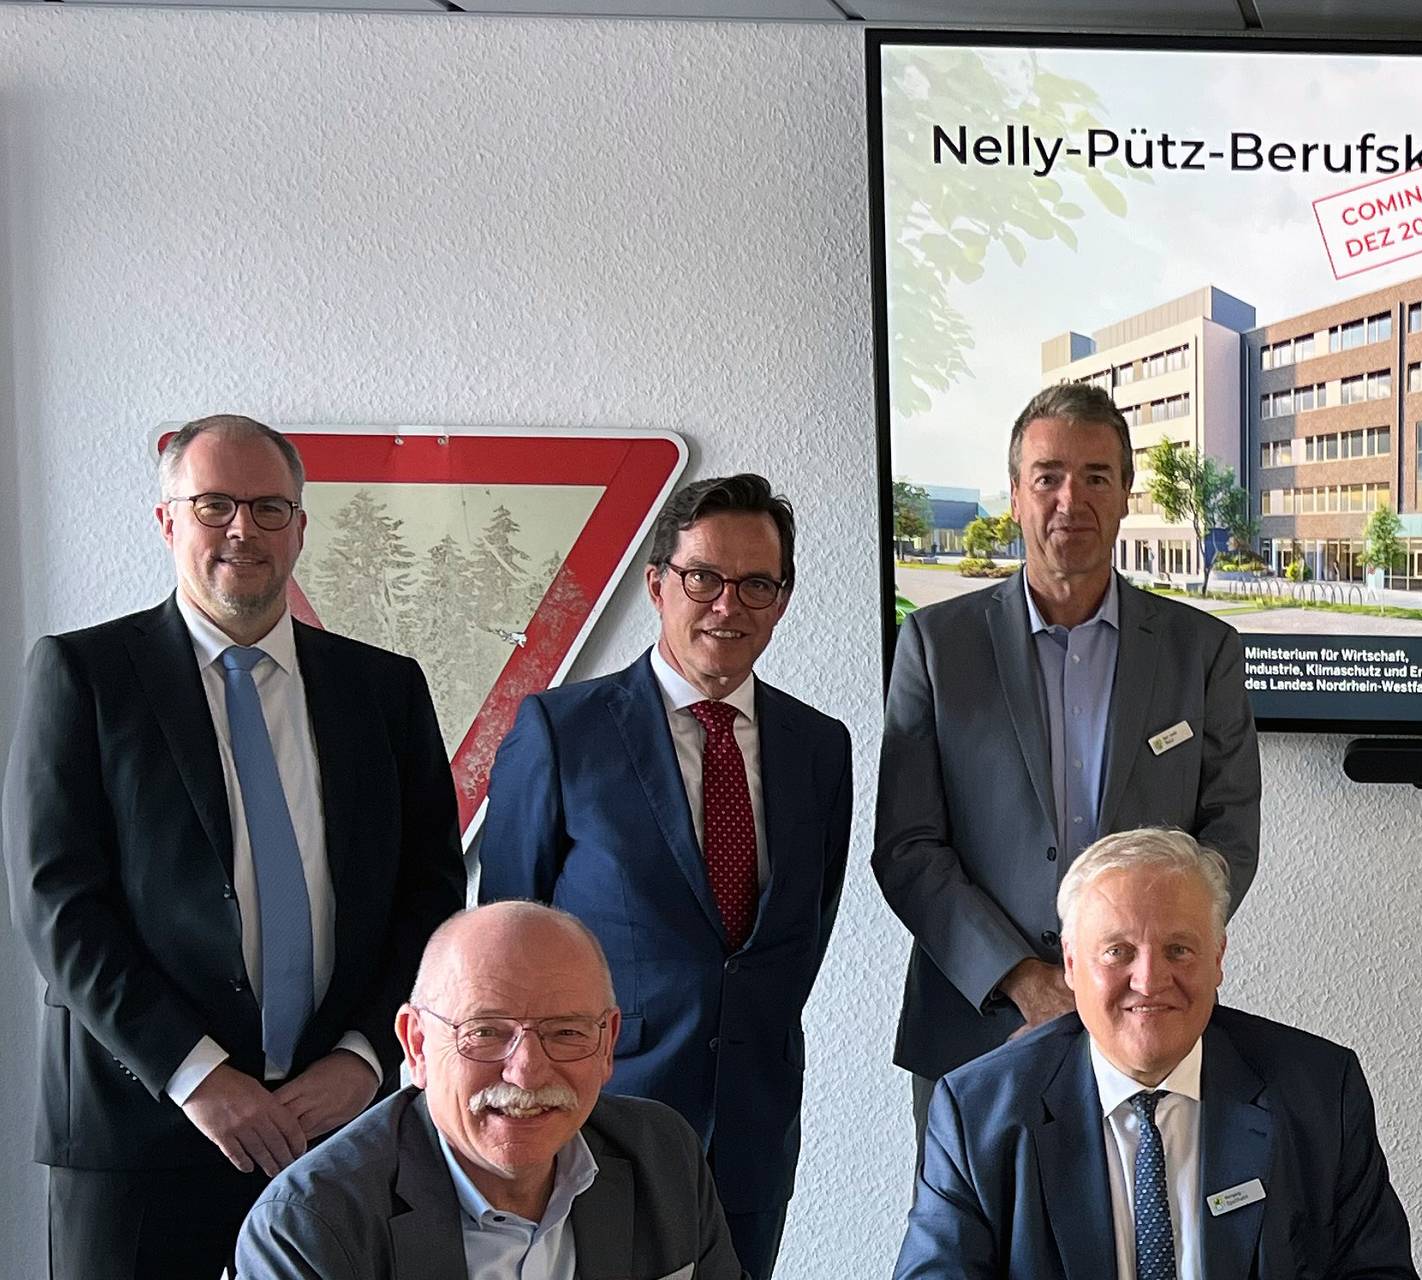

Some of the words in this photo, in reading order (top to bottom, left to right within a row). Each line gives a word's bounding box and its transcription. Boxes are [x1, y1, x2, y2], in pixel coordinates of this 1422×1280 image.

[1345, 227, 1395, 258] DEZ
[1244, 646, 1318, 661] Ministerium
[1320, 648, 1340, 661] für
[1341, 648, 1409, 664] Wirtschaft,
[1244, 662, 1304, 677] Industrie,
[1305, 663, 1382, 677] Klimaschutz
[1383, 664, 1408, 677] und
[1244, 677, 1268, 690] des
[1269, 678, 1314, 691] Landes
